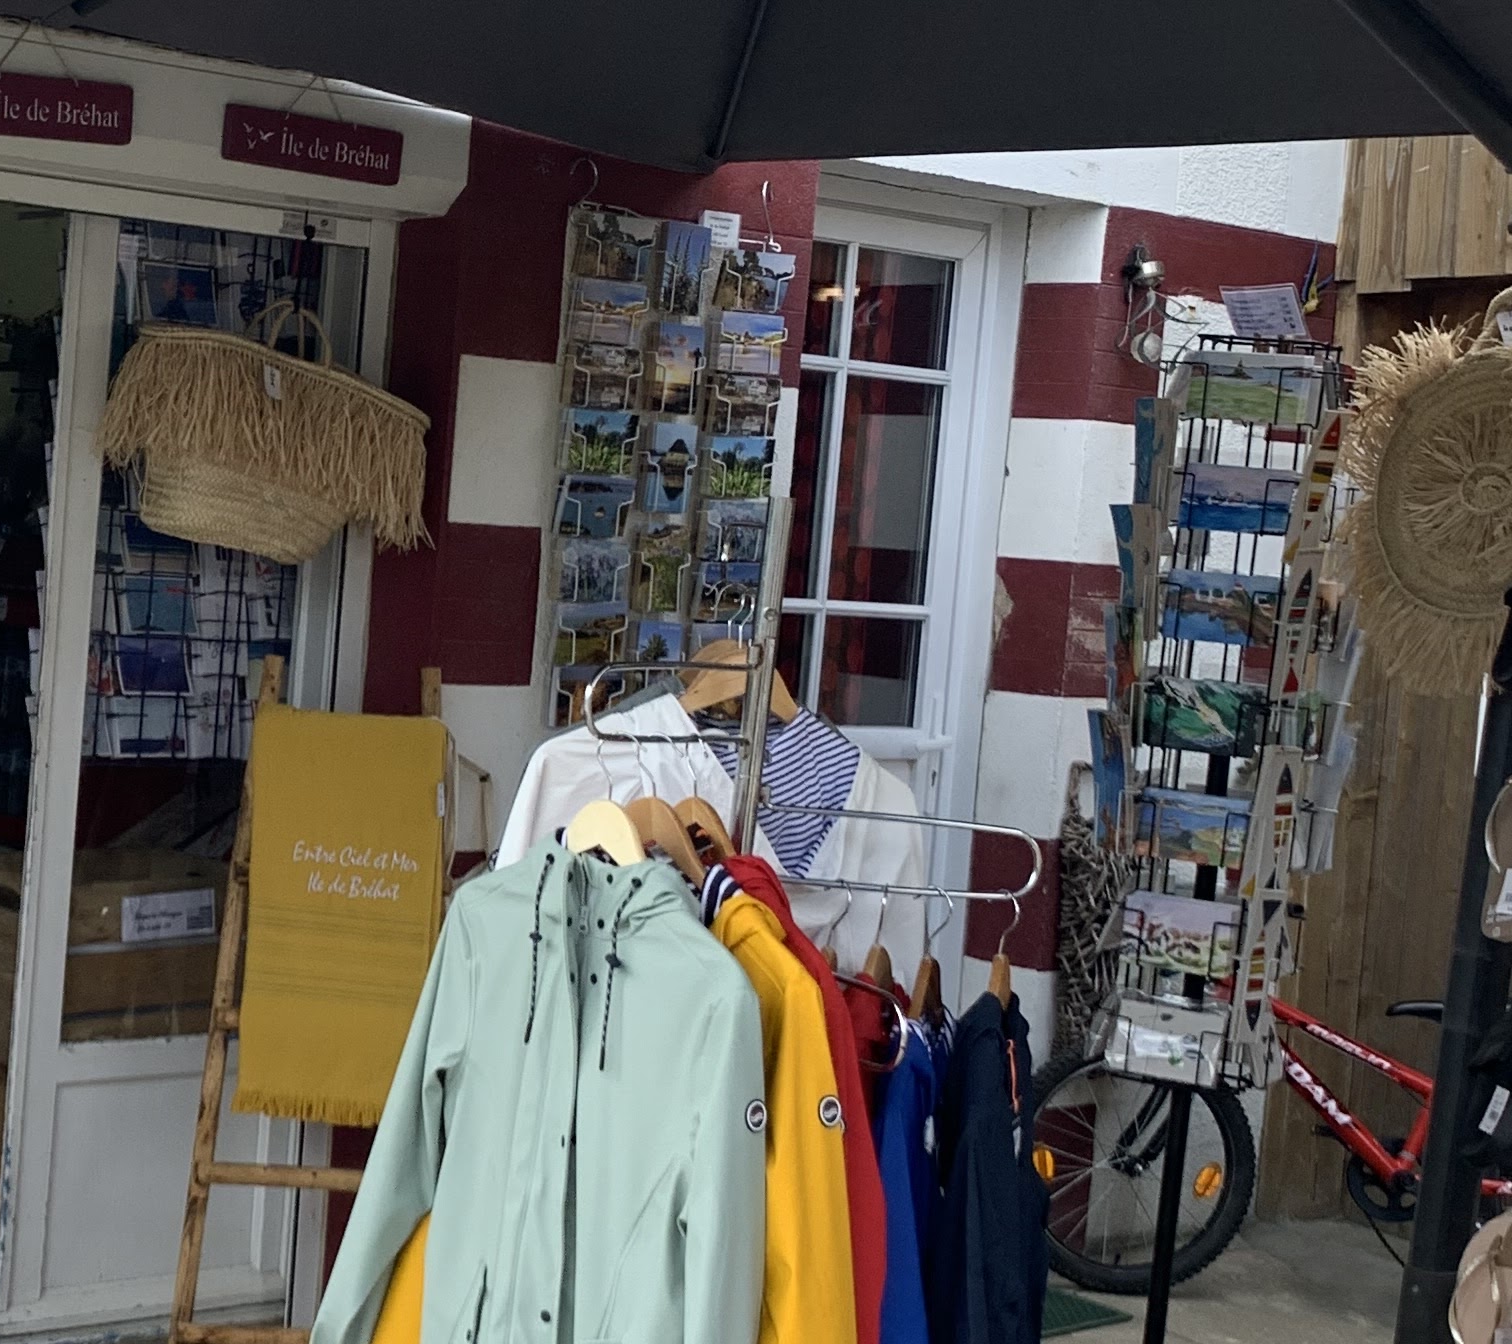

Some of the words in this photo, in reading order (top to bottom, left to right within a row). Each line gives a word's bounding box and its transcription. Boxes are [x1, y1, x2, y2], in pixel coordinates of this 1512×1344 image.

[26, 98, 50, 123] de
[57, 101, 120, 129] Bréhat
[308, 137, 329, 161] de
[334, 142, 390, 171] Bréhat
[292, 839, 337, 864] Entre
[339, 845, 372, 868] Ciel
[390, 849, 419, 873] Mer
[328, 872, 347, 895] de
